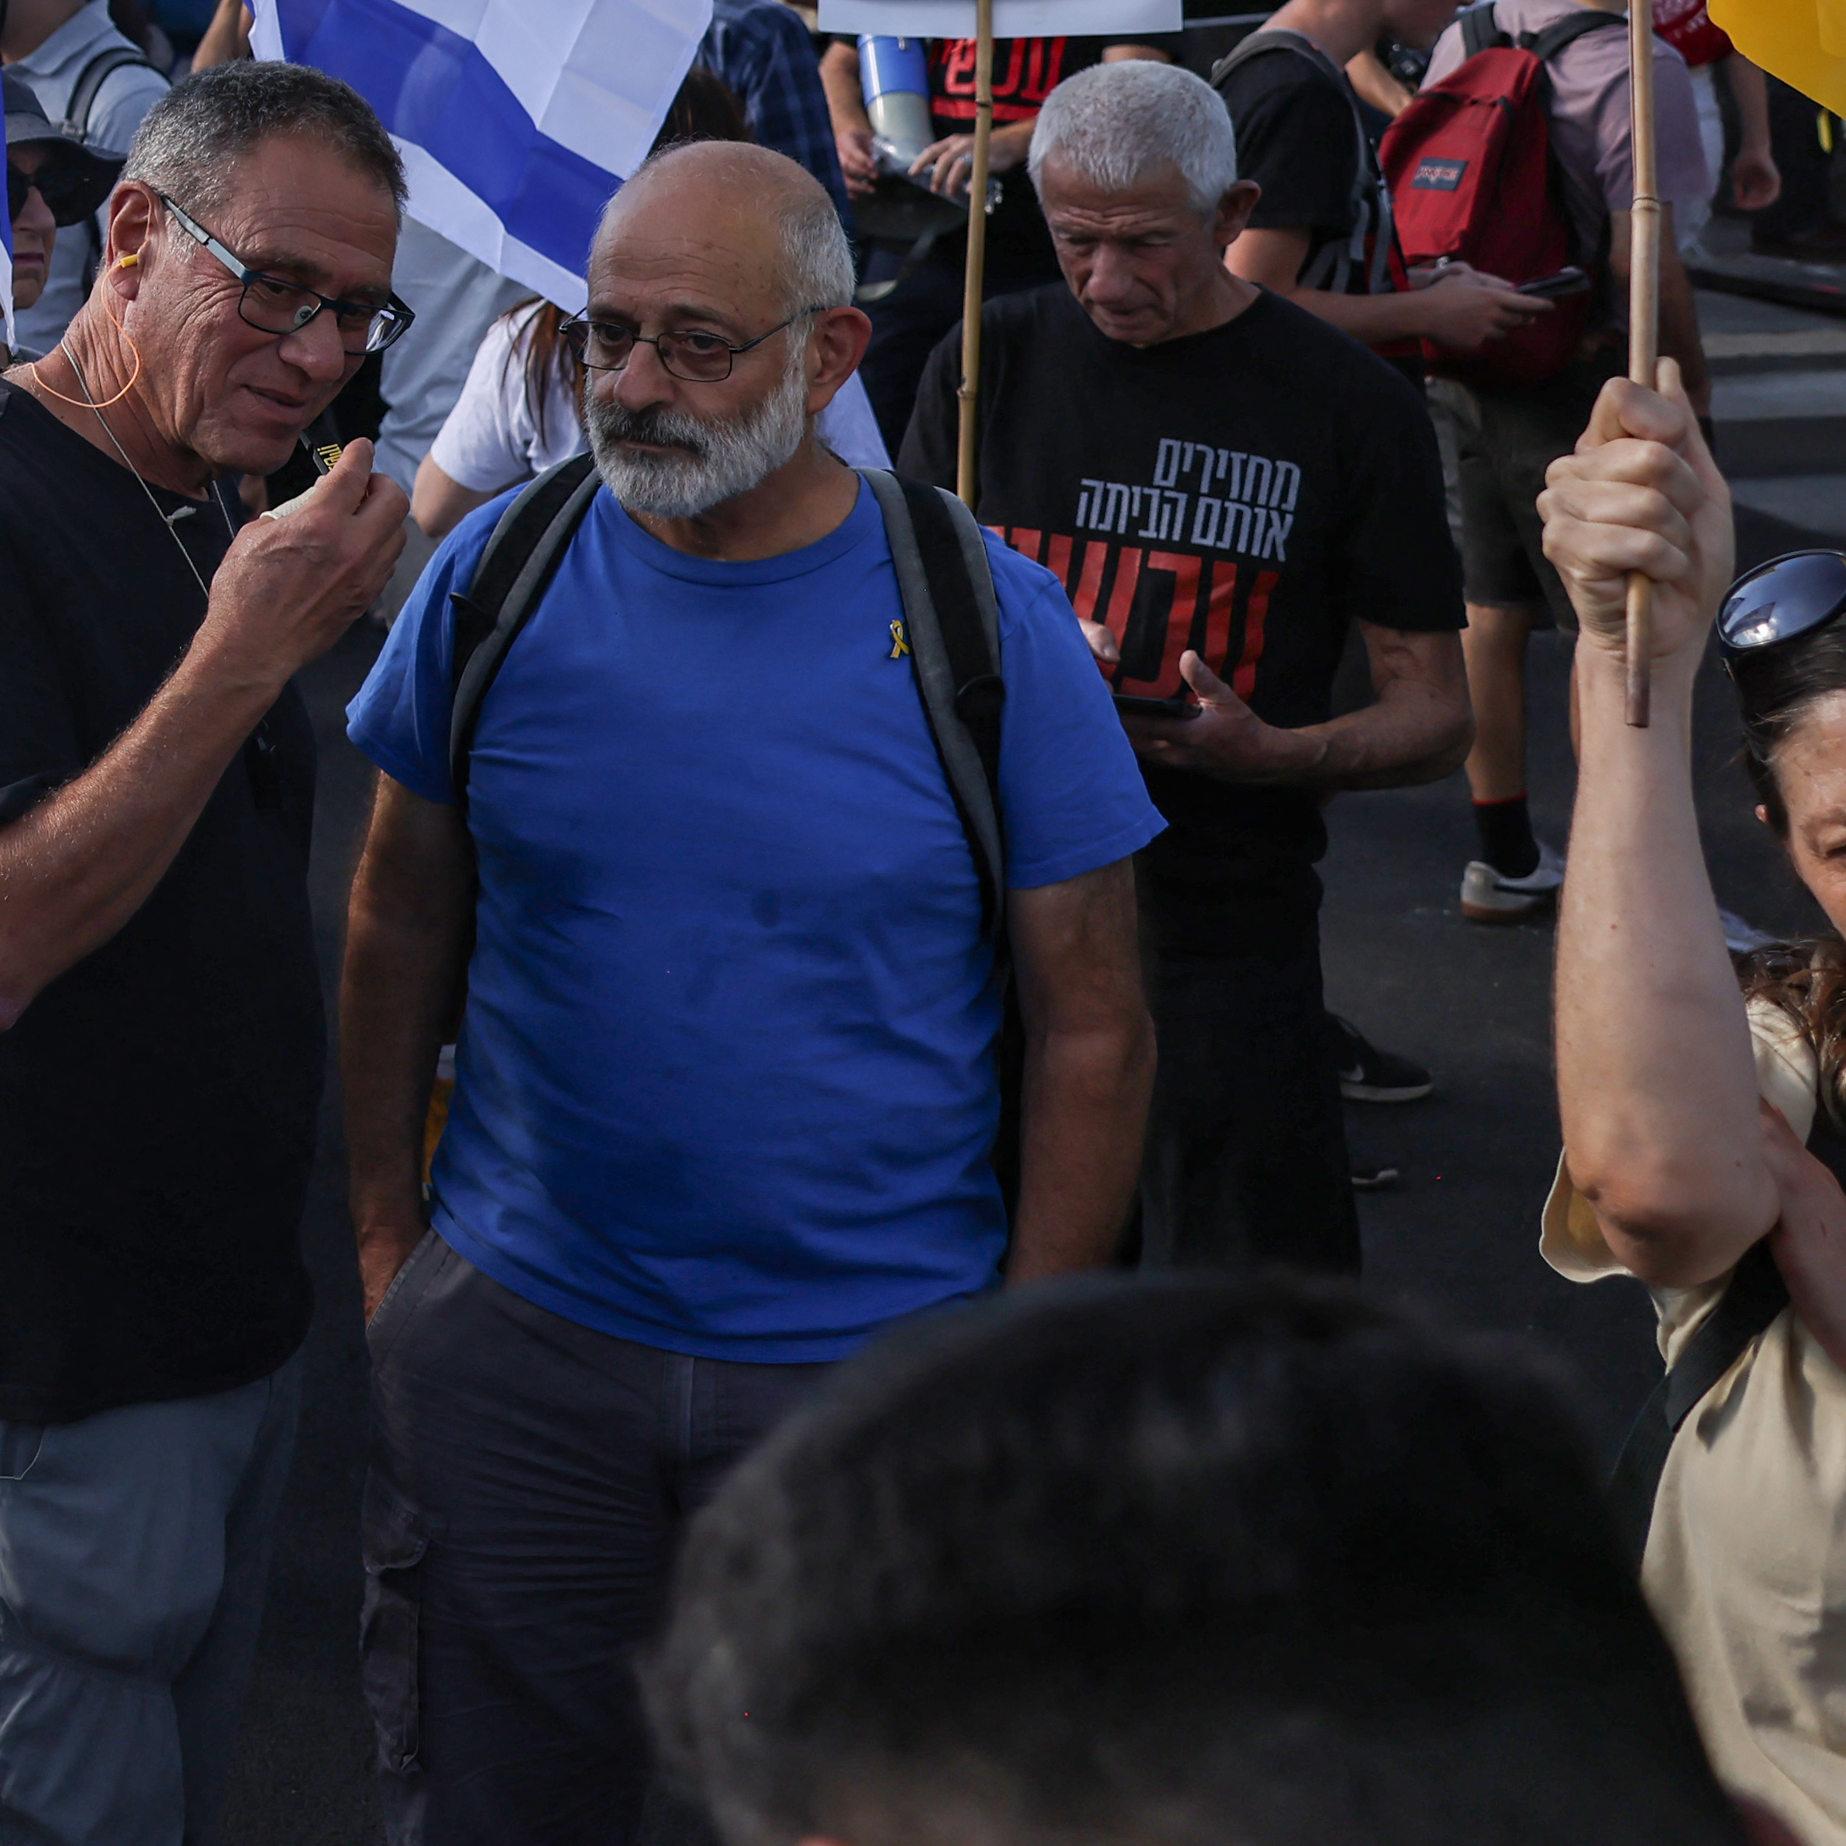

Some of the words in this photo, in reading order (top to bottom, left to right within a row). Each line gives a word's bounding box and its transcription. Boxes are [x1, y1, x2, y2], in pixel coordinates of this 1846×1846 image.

[1153, 436, 1302, 511] מחזירים
[1075, 477, 1188, 544] הביתה
[1191, 498, 1294, 562] אותם
